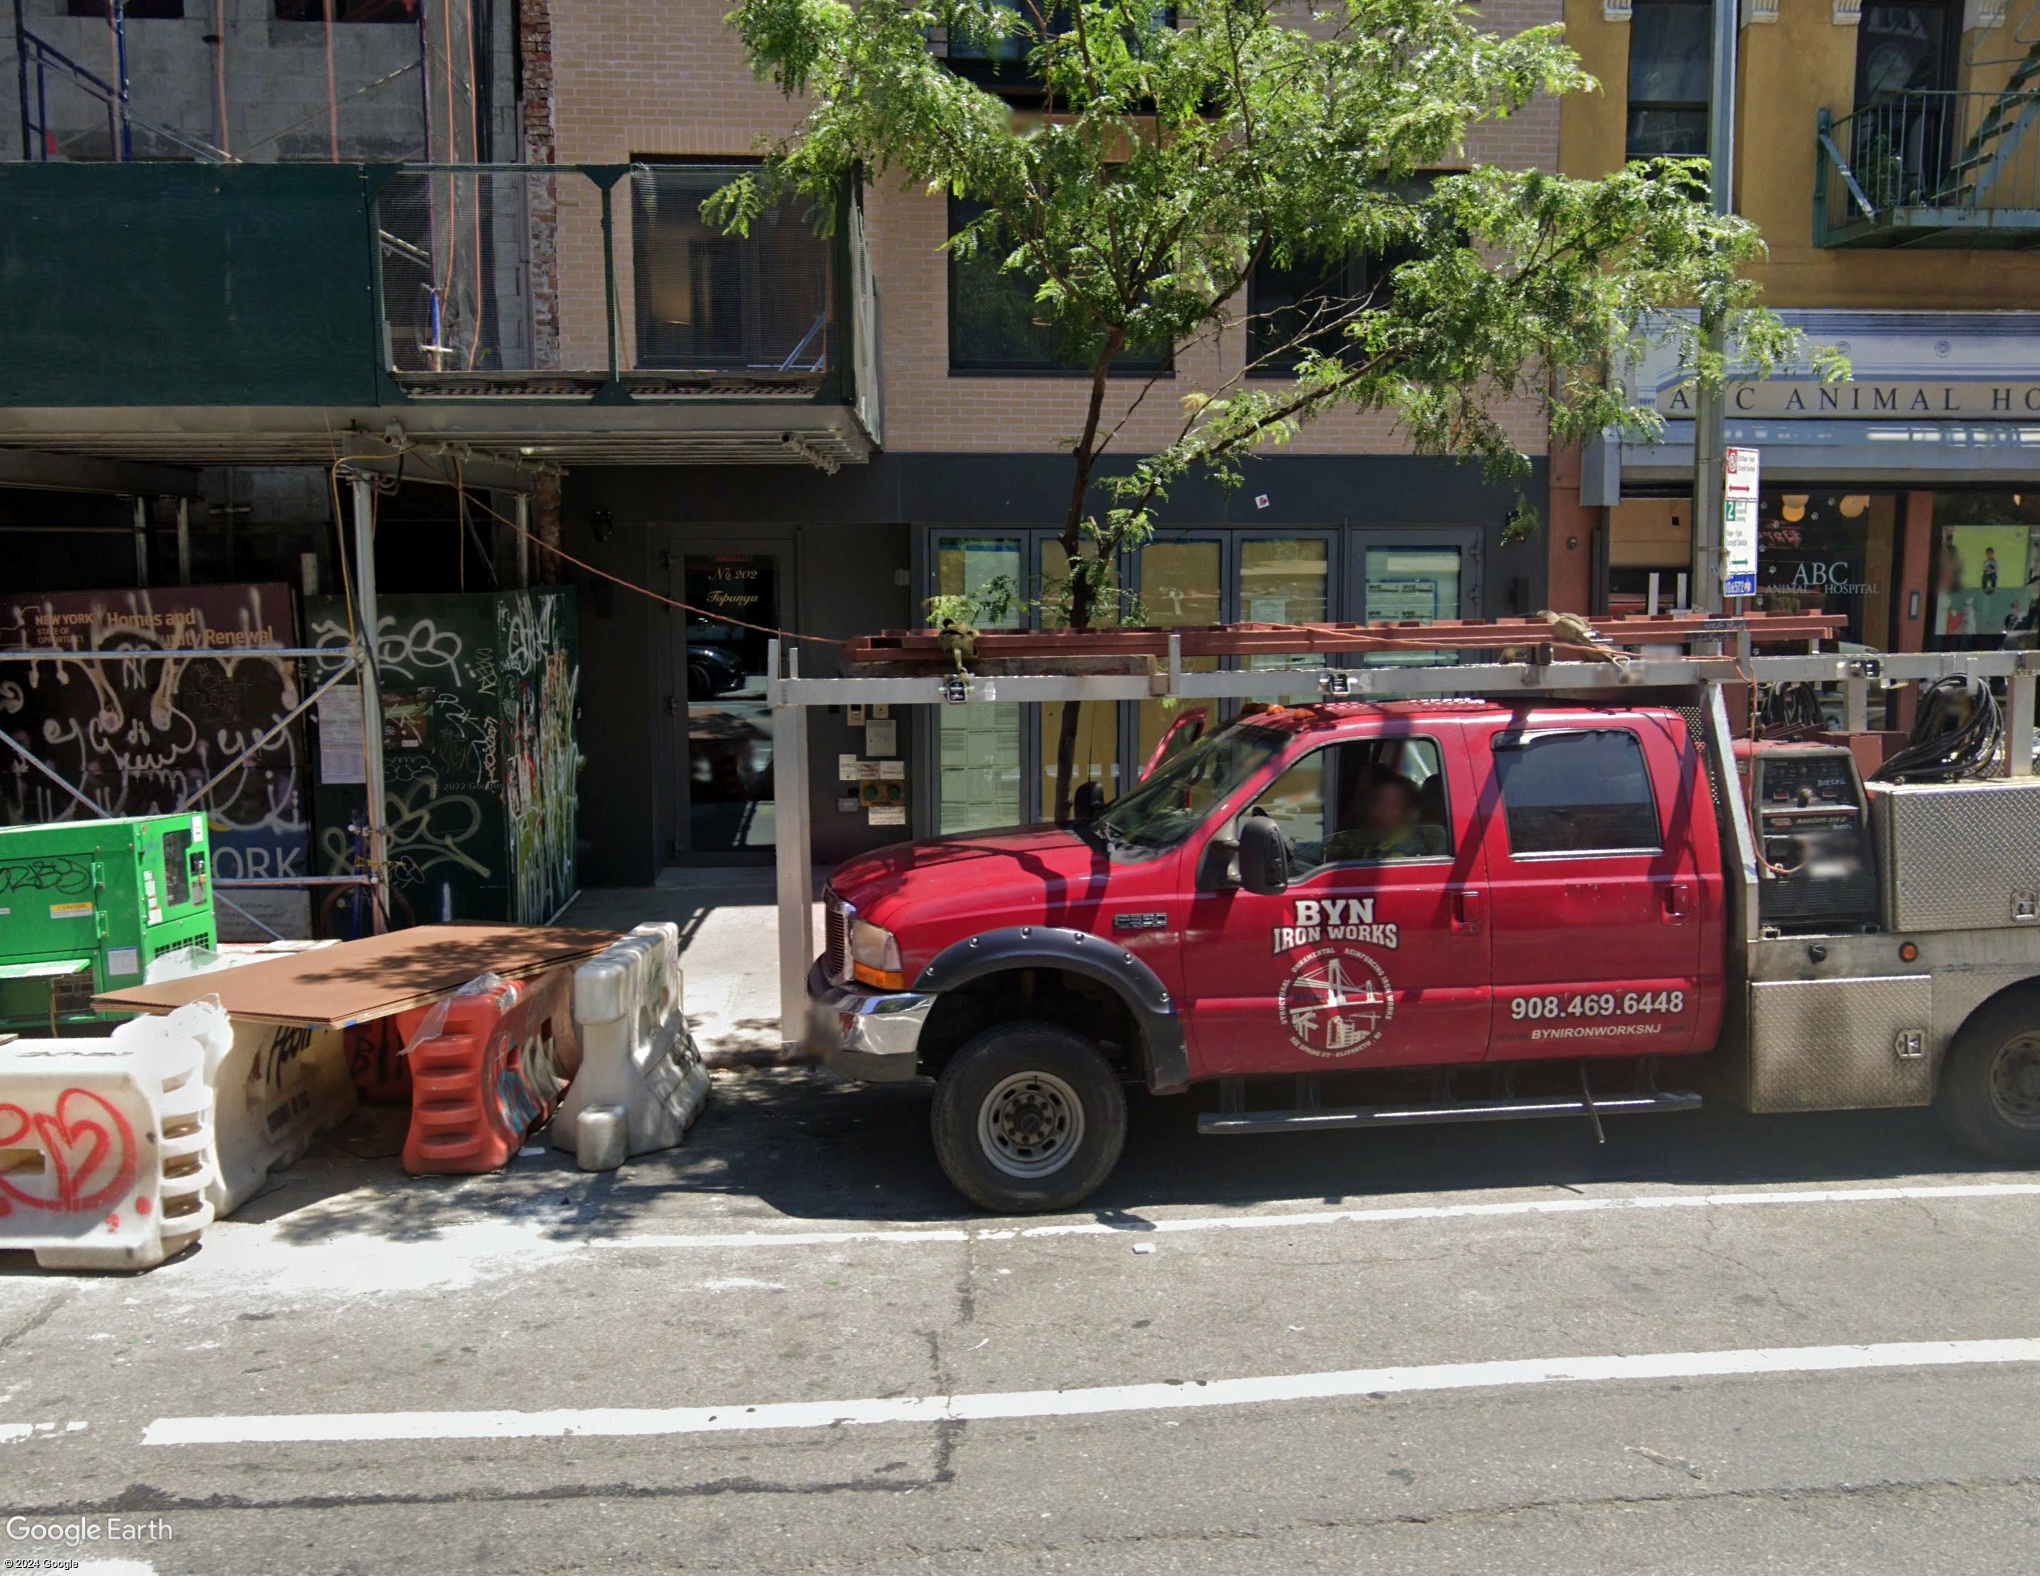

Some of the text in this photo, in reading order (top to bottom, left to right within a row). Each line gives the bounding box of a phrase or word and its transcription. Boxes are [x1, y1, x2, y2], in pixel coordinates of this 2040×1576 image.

[1669, 387, 1755, 410] AC
[1785, 387, 1961, 411] ANIMAL
[734, 569, 758, 580] 202
[1792, 561, 1849, 586] ABC
[706, 590, 760, 607] Topanga
[1765, 583, 1880, 595] ANIMAL HOSPITAL
[34, 612, 94, 626] NEW YORK
[107, 608, 196, 627] Homes and
[36, 626, 71, 636] STAE OF
[206, 626, 274, 646] Renewal
[1295, 898, 1375, 926] BYN
[1273, 923, 1399, 954] IRON WORKS
[1278, 947, 1395, 1026] STRUCTURAL ORNAMENTAL REINFORCING IRON WORKS
[1511, 991, 1684, 1020] 908.469.6448
